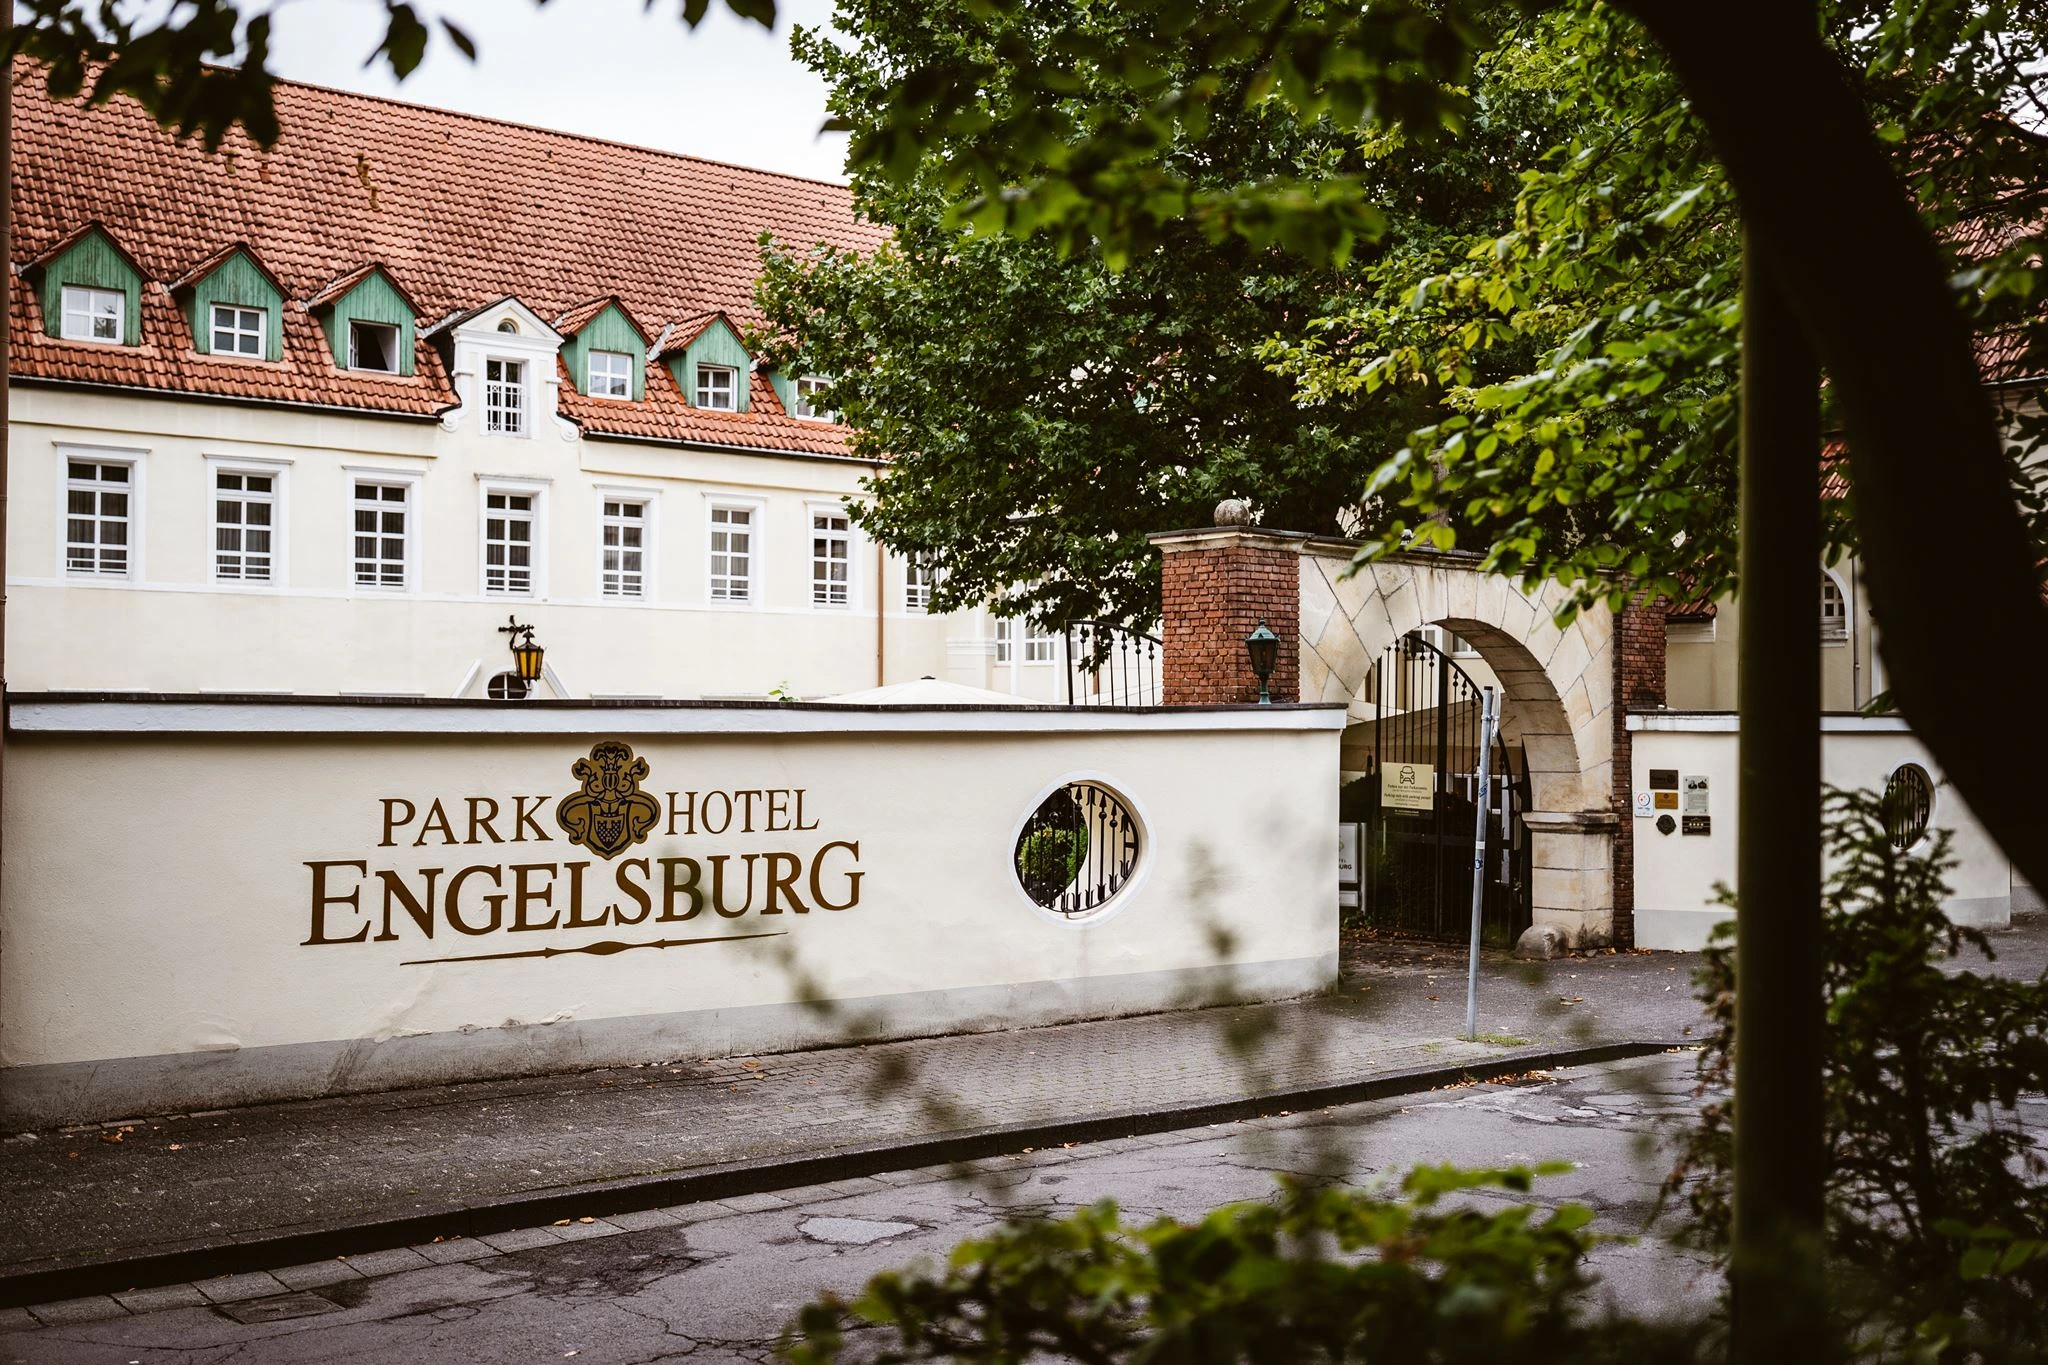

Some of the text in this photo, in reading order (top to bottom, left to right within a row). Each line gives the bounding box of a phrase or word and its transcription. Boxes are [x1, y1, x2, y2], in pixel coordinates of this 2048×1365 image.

[377, 789, 820, 848] PARK HOTEL
[299, 840, 866, 947] ENGELSBURG
